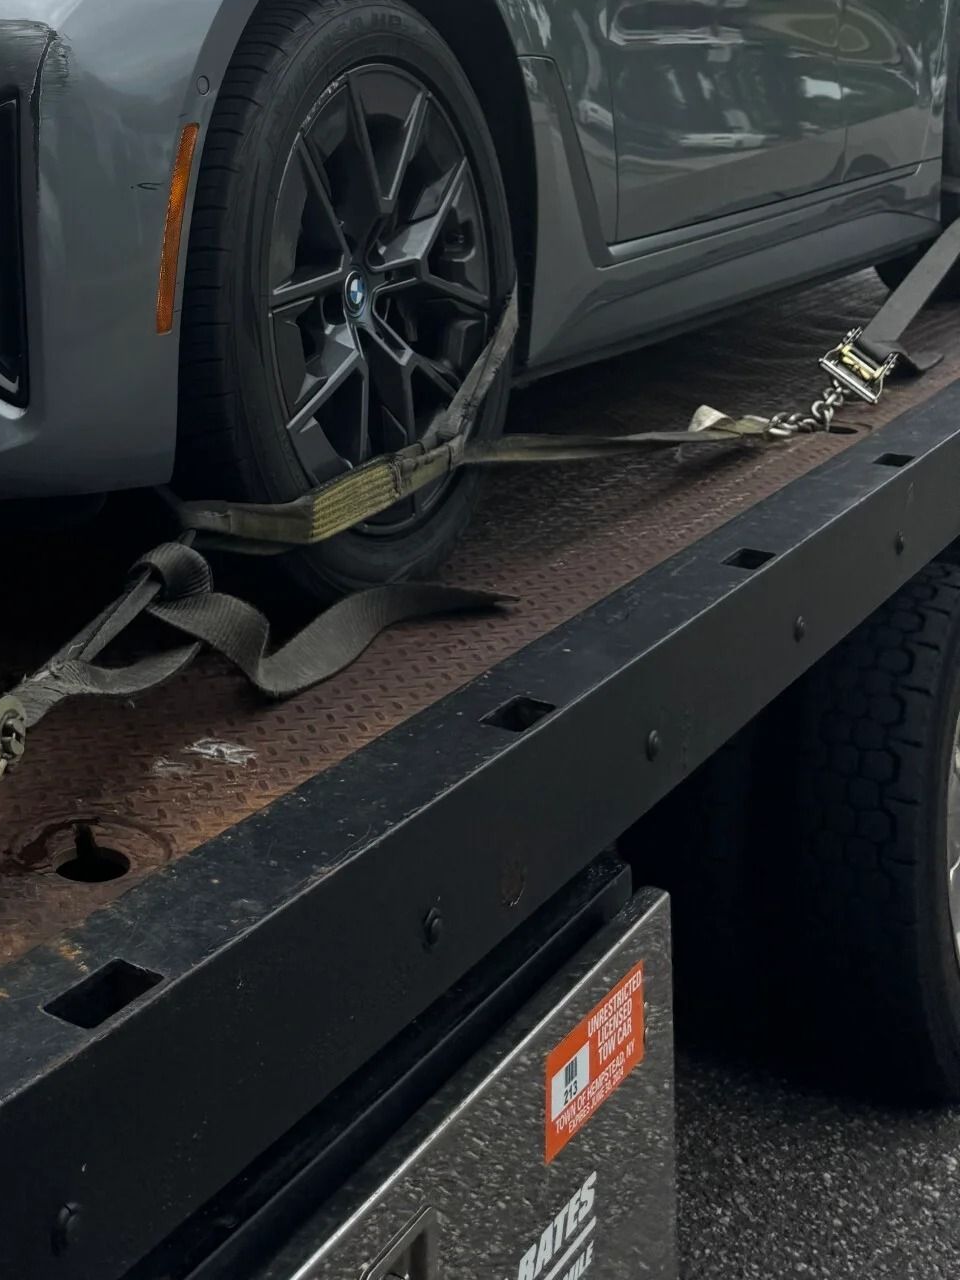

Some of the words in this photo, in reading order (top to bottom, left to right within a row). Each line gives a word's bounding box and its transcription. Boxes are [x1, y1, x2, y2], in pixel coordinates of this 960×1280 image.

[587, 970, 642, 1038] UNRESTRICTED
[597, 998, 632, 1048] LICENSED
[599, 1039, 616, 1065] TOW
[617, 1017, 632, 1045] CAR
[556, 1100, 577, 1134] TOWN
[577, 1091, 586, 1111] OF
[626, 1037, 635, 1059] NY
[563, 1080, 578, 1107] 213
[568, 1102, 590, 1134] EXPIRES
[590, 1087, 605, 1110] JUNE
[518, 1171, 597, 1280] RATES
